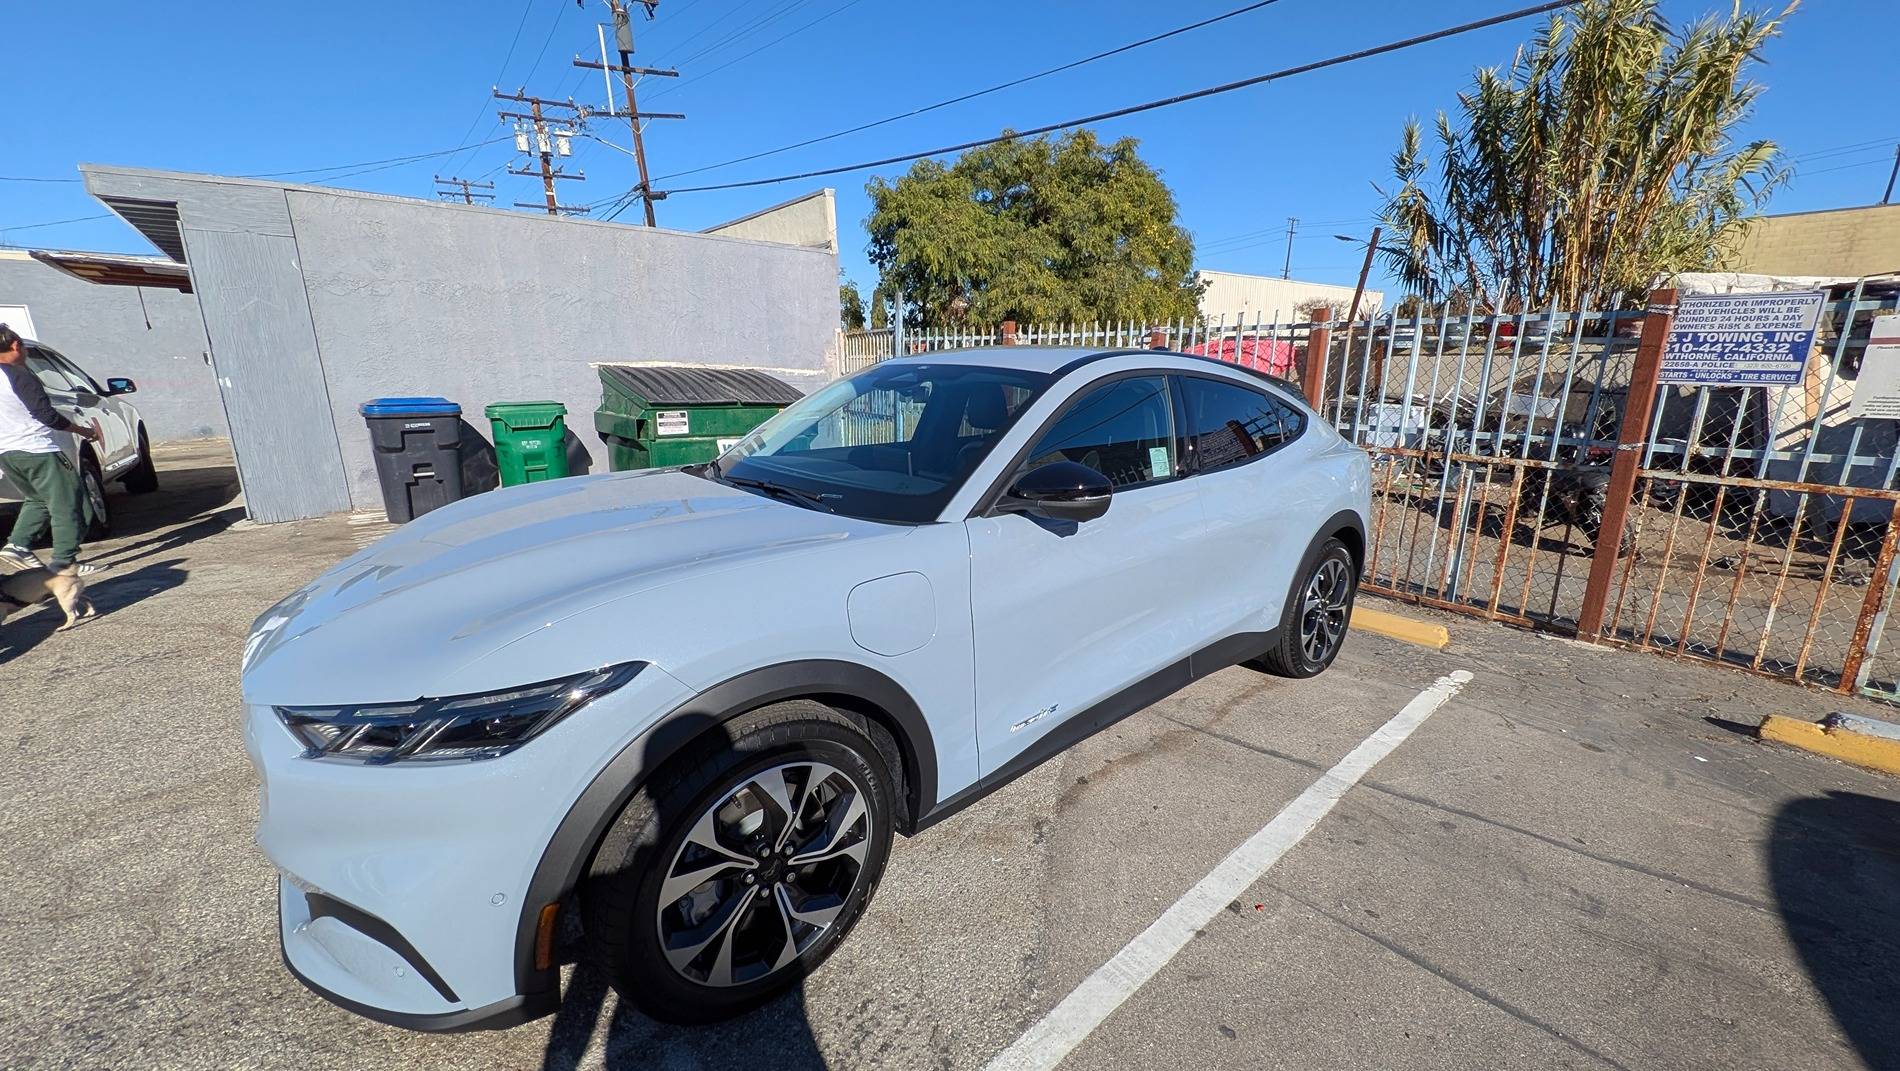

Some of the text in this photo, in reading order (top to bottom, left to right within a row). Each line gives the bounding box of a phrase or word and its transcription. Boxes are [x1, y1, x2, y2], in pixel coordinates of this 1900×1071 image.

[1751, 298, 1819, 307] IMPROPERLY
[1786, 306, 1801, 314] BE
[1668, 332, 1807, 345] & J TOWING, INC
[1662, 352, 1794, 361] WTHORNE, CALIFORNIA
[1694, 372, 1733, 380] UNLOCKS
[1760, 373, 1797, 381] SERVICE
